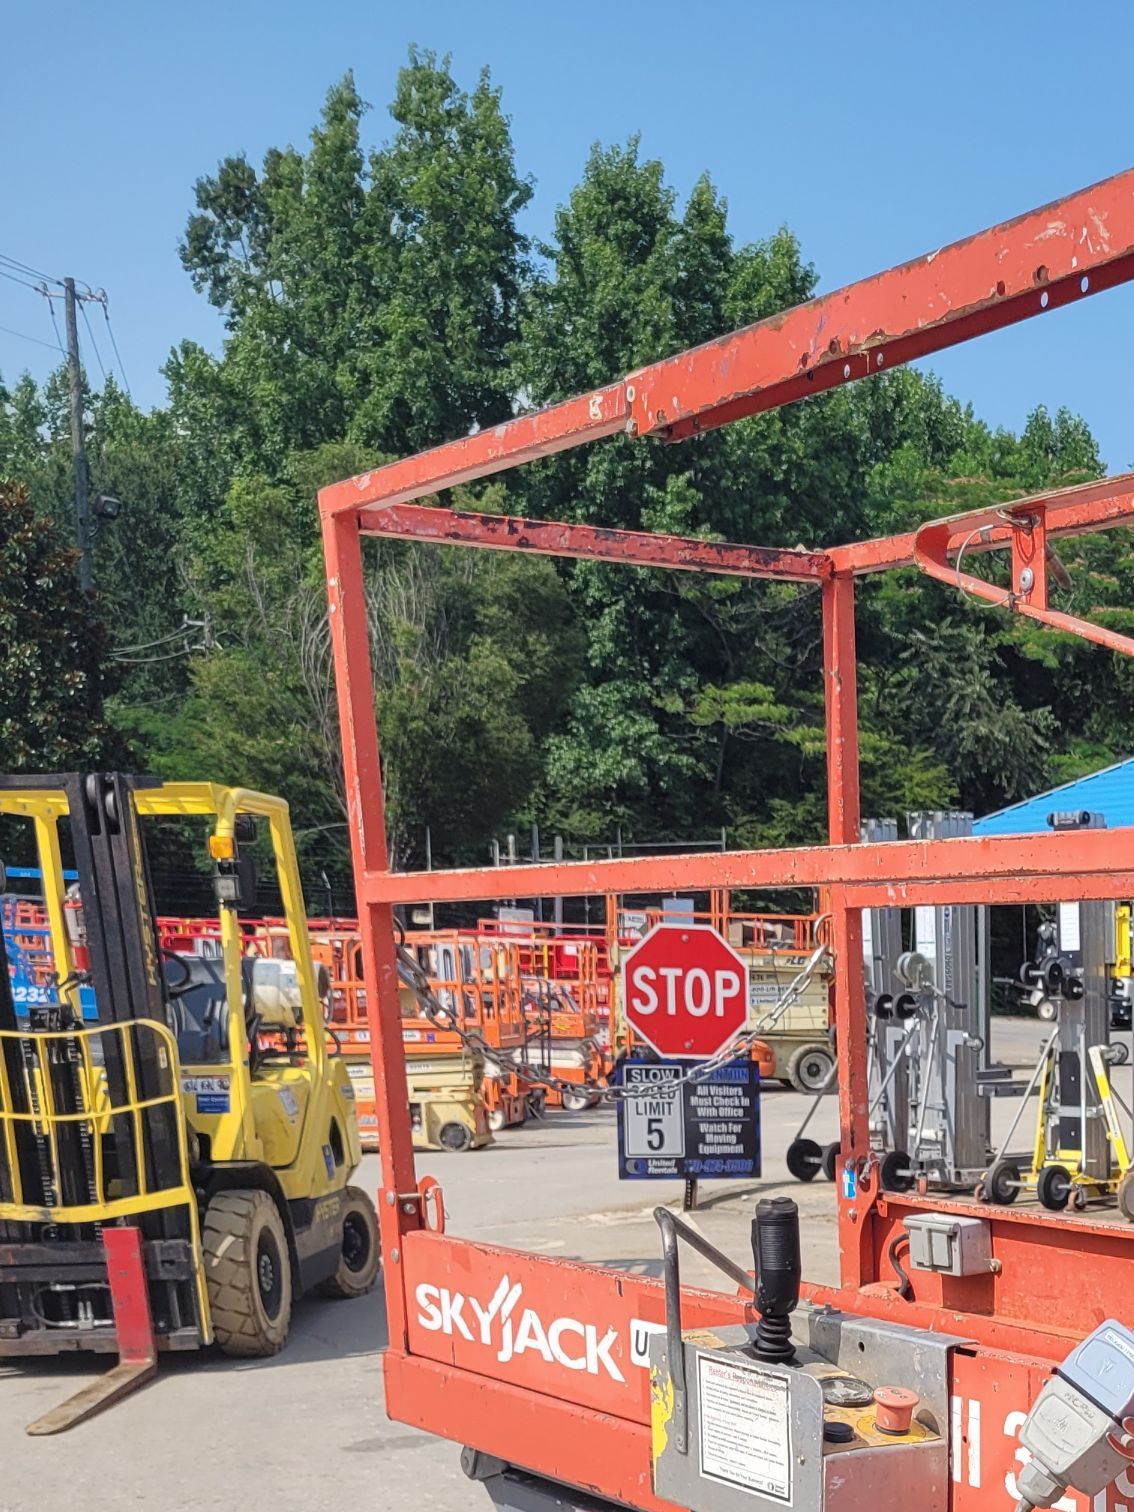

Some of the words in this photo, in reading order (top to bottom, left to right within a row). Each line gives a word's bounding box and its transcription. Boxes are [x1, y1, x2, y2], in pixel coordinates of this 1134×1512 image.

[631, 966, 741, 1017] STOP
[631, 1069, 675, 1083] SLOW
[696, 1085, 709, 1096] All
[710, 1085, 743, 1096] Visitors
[690, 1096, 712, 1107] Must
[713, 1096, 742, 1107] Check
[636, 1102, 674, 1116] LIMIT
[697, 1107, 718, 1117] With
[719, 1107, 744, 1117] Office
[699, 1123, 728, 1133] Watch
[729, 1123, 743, 1133] For
[647, 1118, 665, 1151] 5
[705, 1134, 737, 1144] Moving
[698, 1144, 744, 1155] Equipment
[648, 1159, 676, 1167] United
[648, 1166, 678, 1175] Rentals
[415, 1274, 626, 1383] SKYJACK
